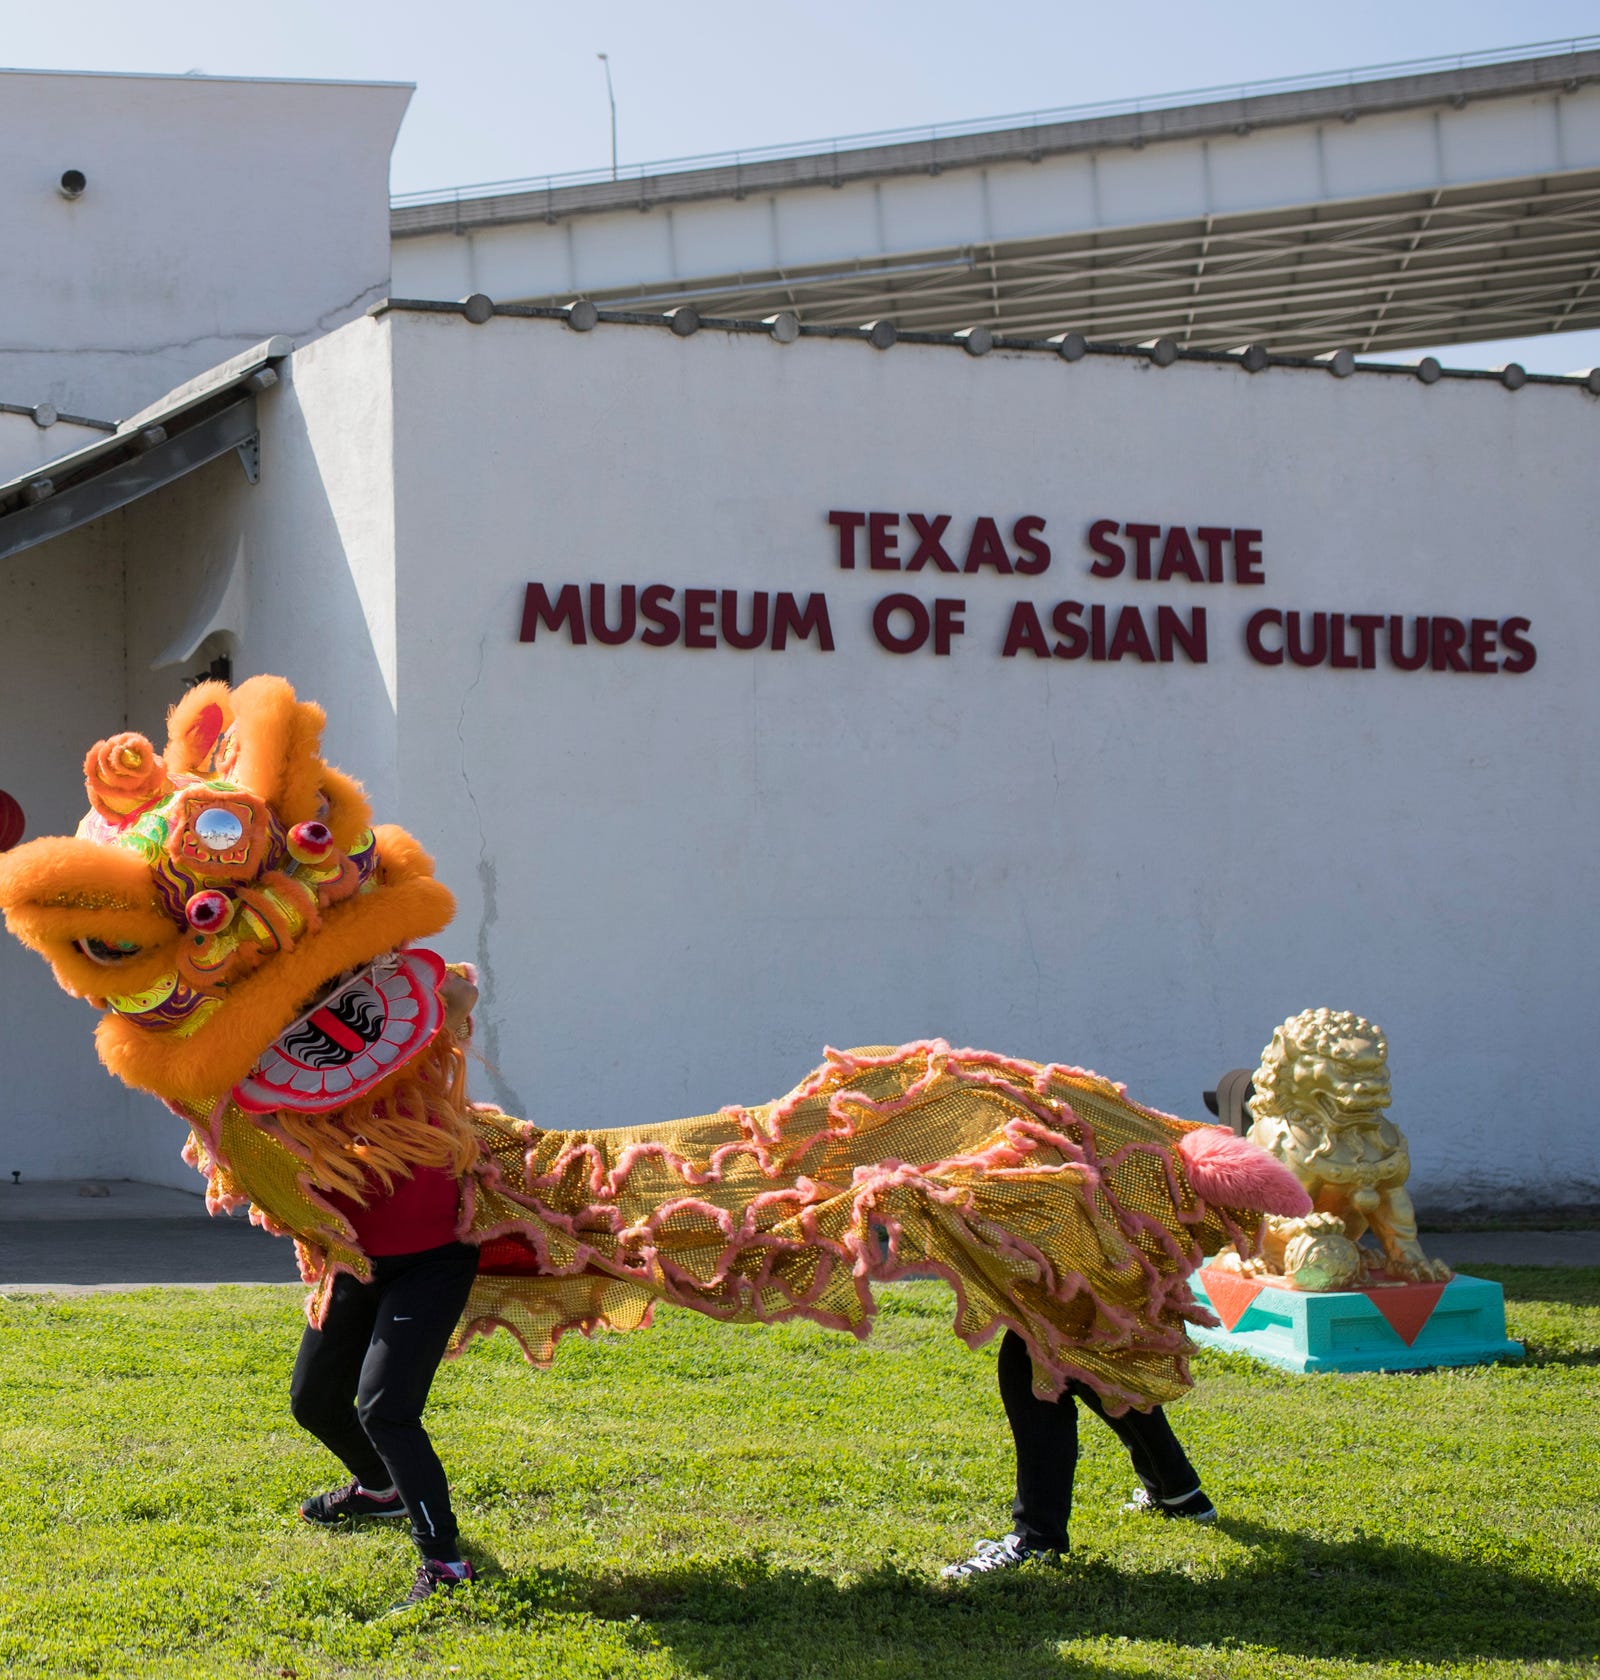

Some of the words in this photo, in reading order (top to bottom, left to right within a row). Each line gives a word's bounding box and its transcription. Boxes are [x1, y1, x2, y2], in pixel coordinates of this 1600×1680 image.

[828, 510, 1052, 576] TEXAS
[1087, 518, 1265, 585] STATE
[519, 582, 835, 651] MUSEUM
[872, 593, 967, 656] OF
[1002, 601, 1208, 664] ASIAN
[1245, 608, 1536, 674] CULTURES
